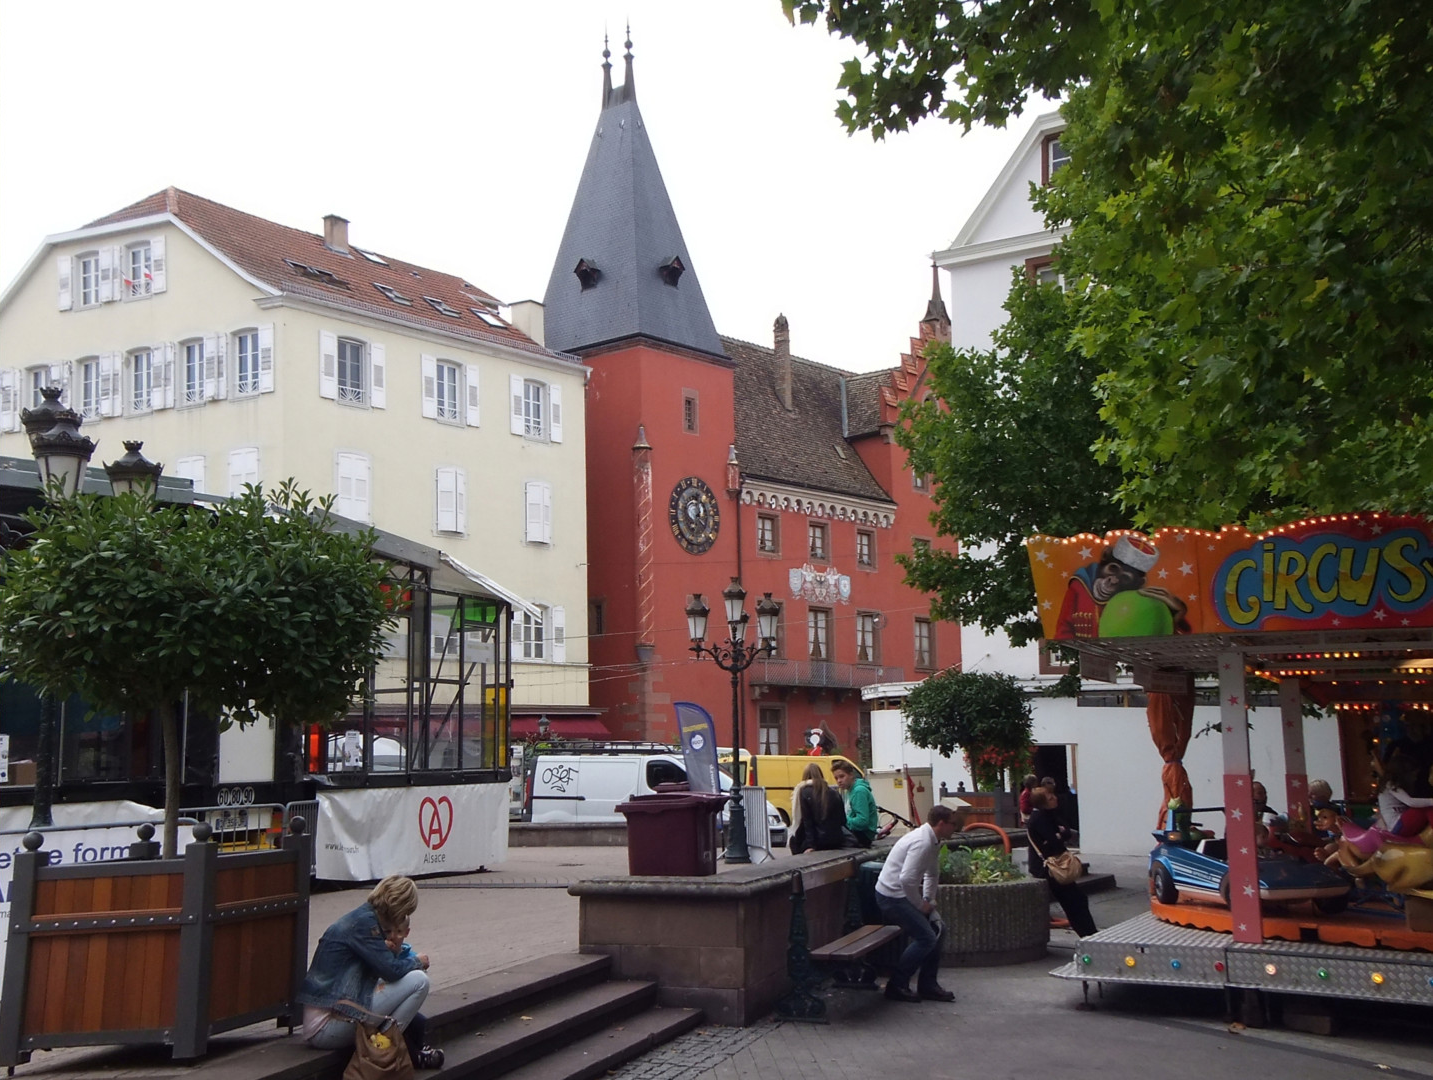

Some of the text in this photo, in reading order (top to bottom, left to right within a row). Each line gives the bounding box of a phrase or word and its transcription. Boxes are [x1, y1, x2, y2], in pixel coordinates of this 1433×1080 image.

[219, 788, 253, 805] 60 80 90
[423, 852, 446, 864] Alsace
